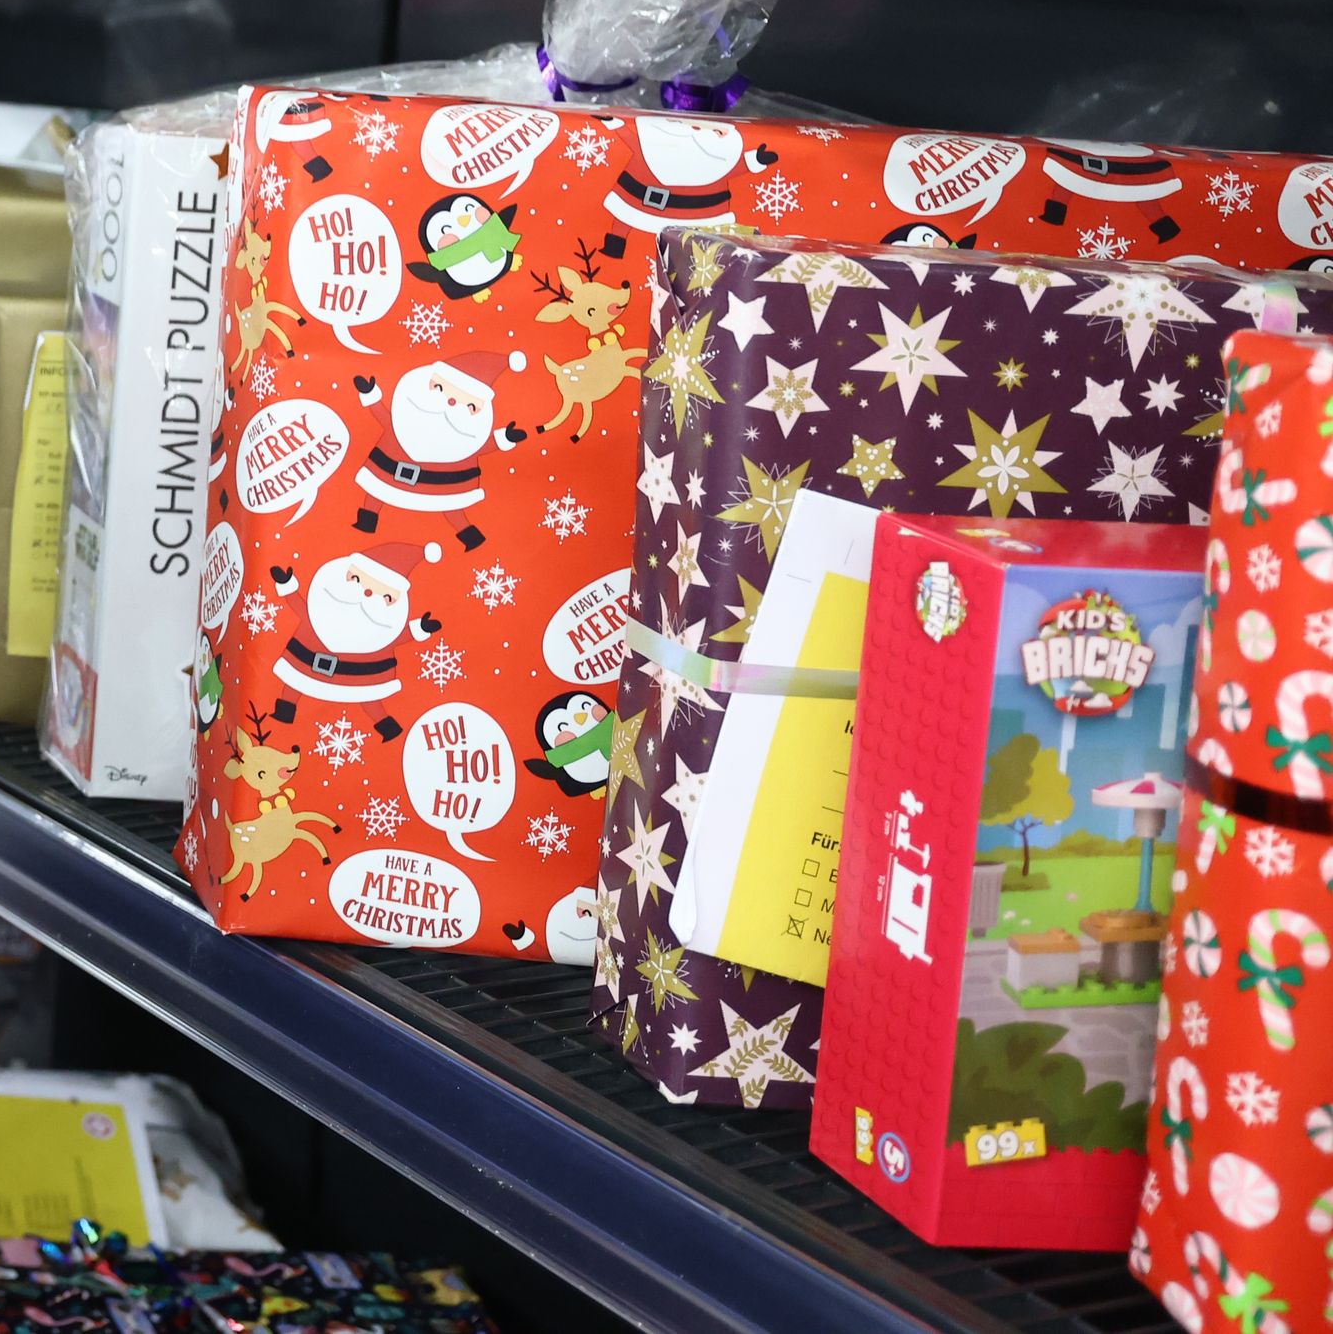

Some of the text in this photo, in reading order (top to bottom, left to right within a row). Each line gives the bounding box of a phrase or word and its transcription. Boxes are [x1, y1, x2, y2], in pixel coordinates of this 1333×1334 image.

[451, 112, 554, 184] CHRISTMAS
[915, 142, 1020, 212] CHRISTMAS
[308, 207, 353, 243] HO!
[332, 235, 387, 276] HO!
[318, 281, 368, 316] HO!
[150, 191, 218, 577] SCHMIDT PUZZLE
[245, 413, 315, 481] MERRY
[247, 412, 277, 443] HAVE A
[247, 433, 342, 507] CHRISTMAS
[203, 537, 230, 597] MERRY
[203, 562, 240, 623] CHRISTMAS
[569, 582, 615, 618] HAVE A
[1057, 609, 1126, 632] KID'S
[422, 716, 466, 751] HO!
[104, 765, 148, 786] Disney
[445, 744, 500, 784] HO!
[432, 789, 482, 823] HO!
[385, 855, 432, 876] HAVE A
[361, 871, 459, 913] MERRY
[342, 898, 463, 939] CHRISTMAS
